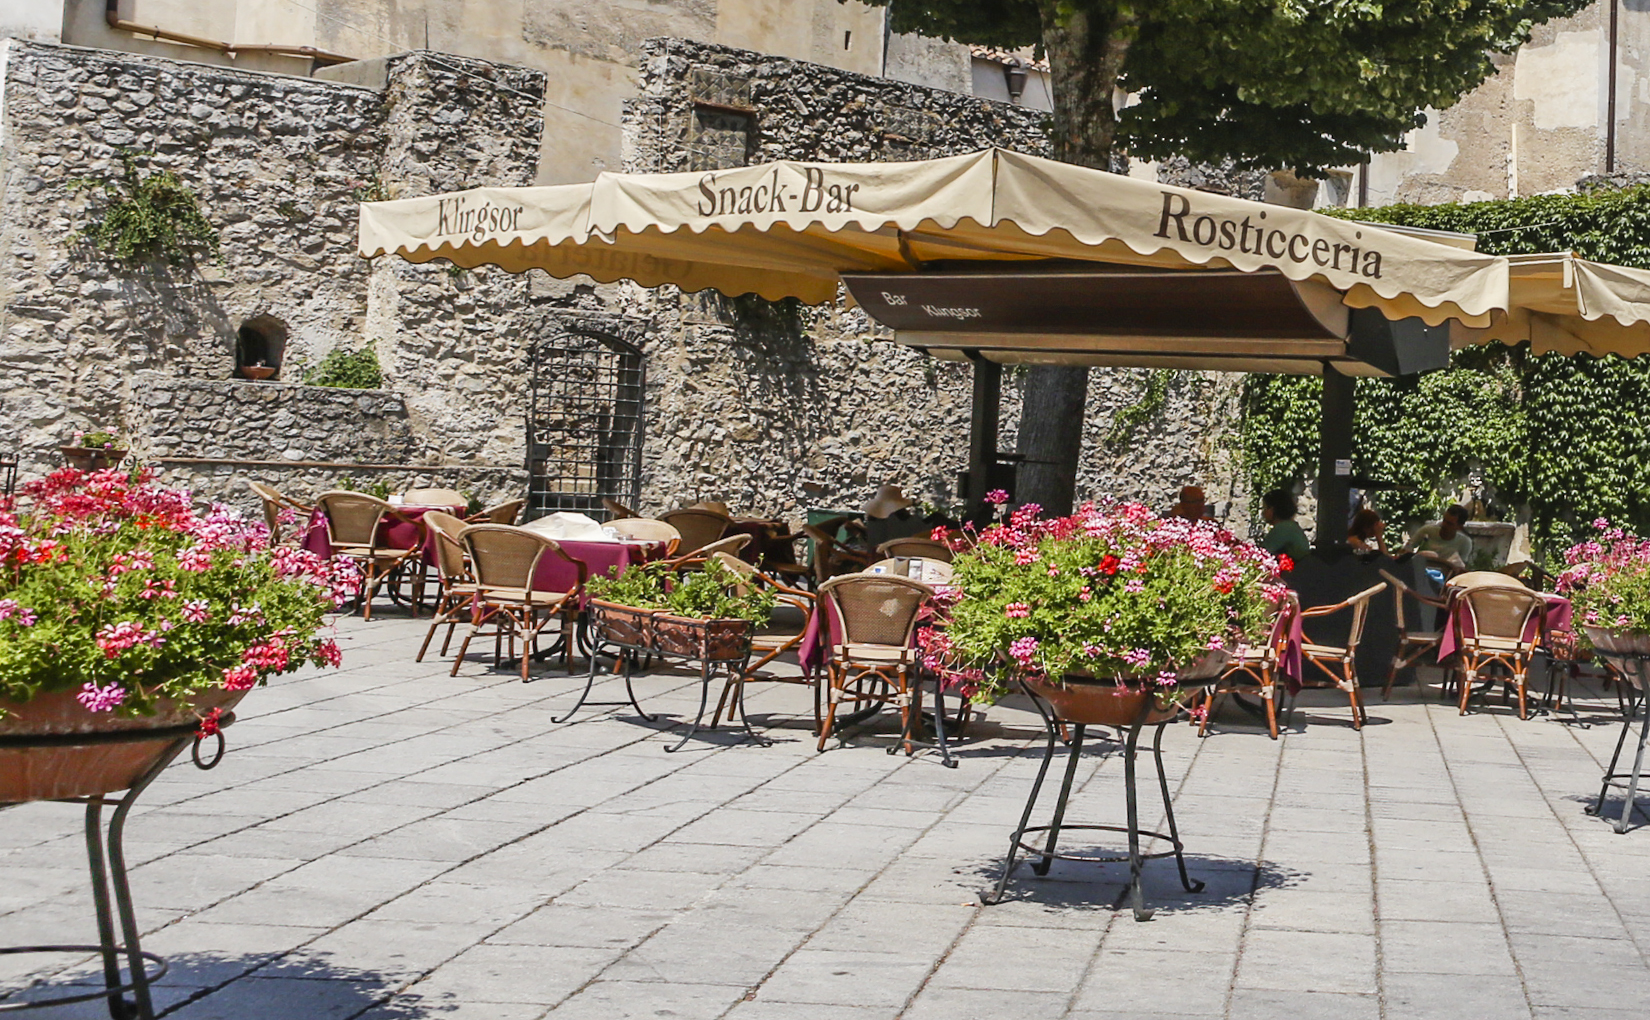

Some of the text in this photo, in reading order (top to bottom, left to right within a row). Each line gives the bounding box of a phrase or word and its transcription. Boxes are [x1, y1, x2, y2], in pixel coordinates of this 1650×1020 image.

[697, 167, 860, 217] Snack-Bar
[436, 196, 523, 242] Klingsor
[1153, 190, 1382, 279] Rosticceria
[881, 291, 908, 306] Bar
[921, 304, 982, 320] Klingsor
